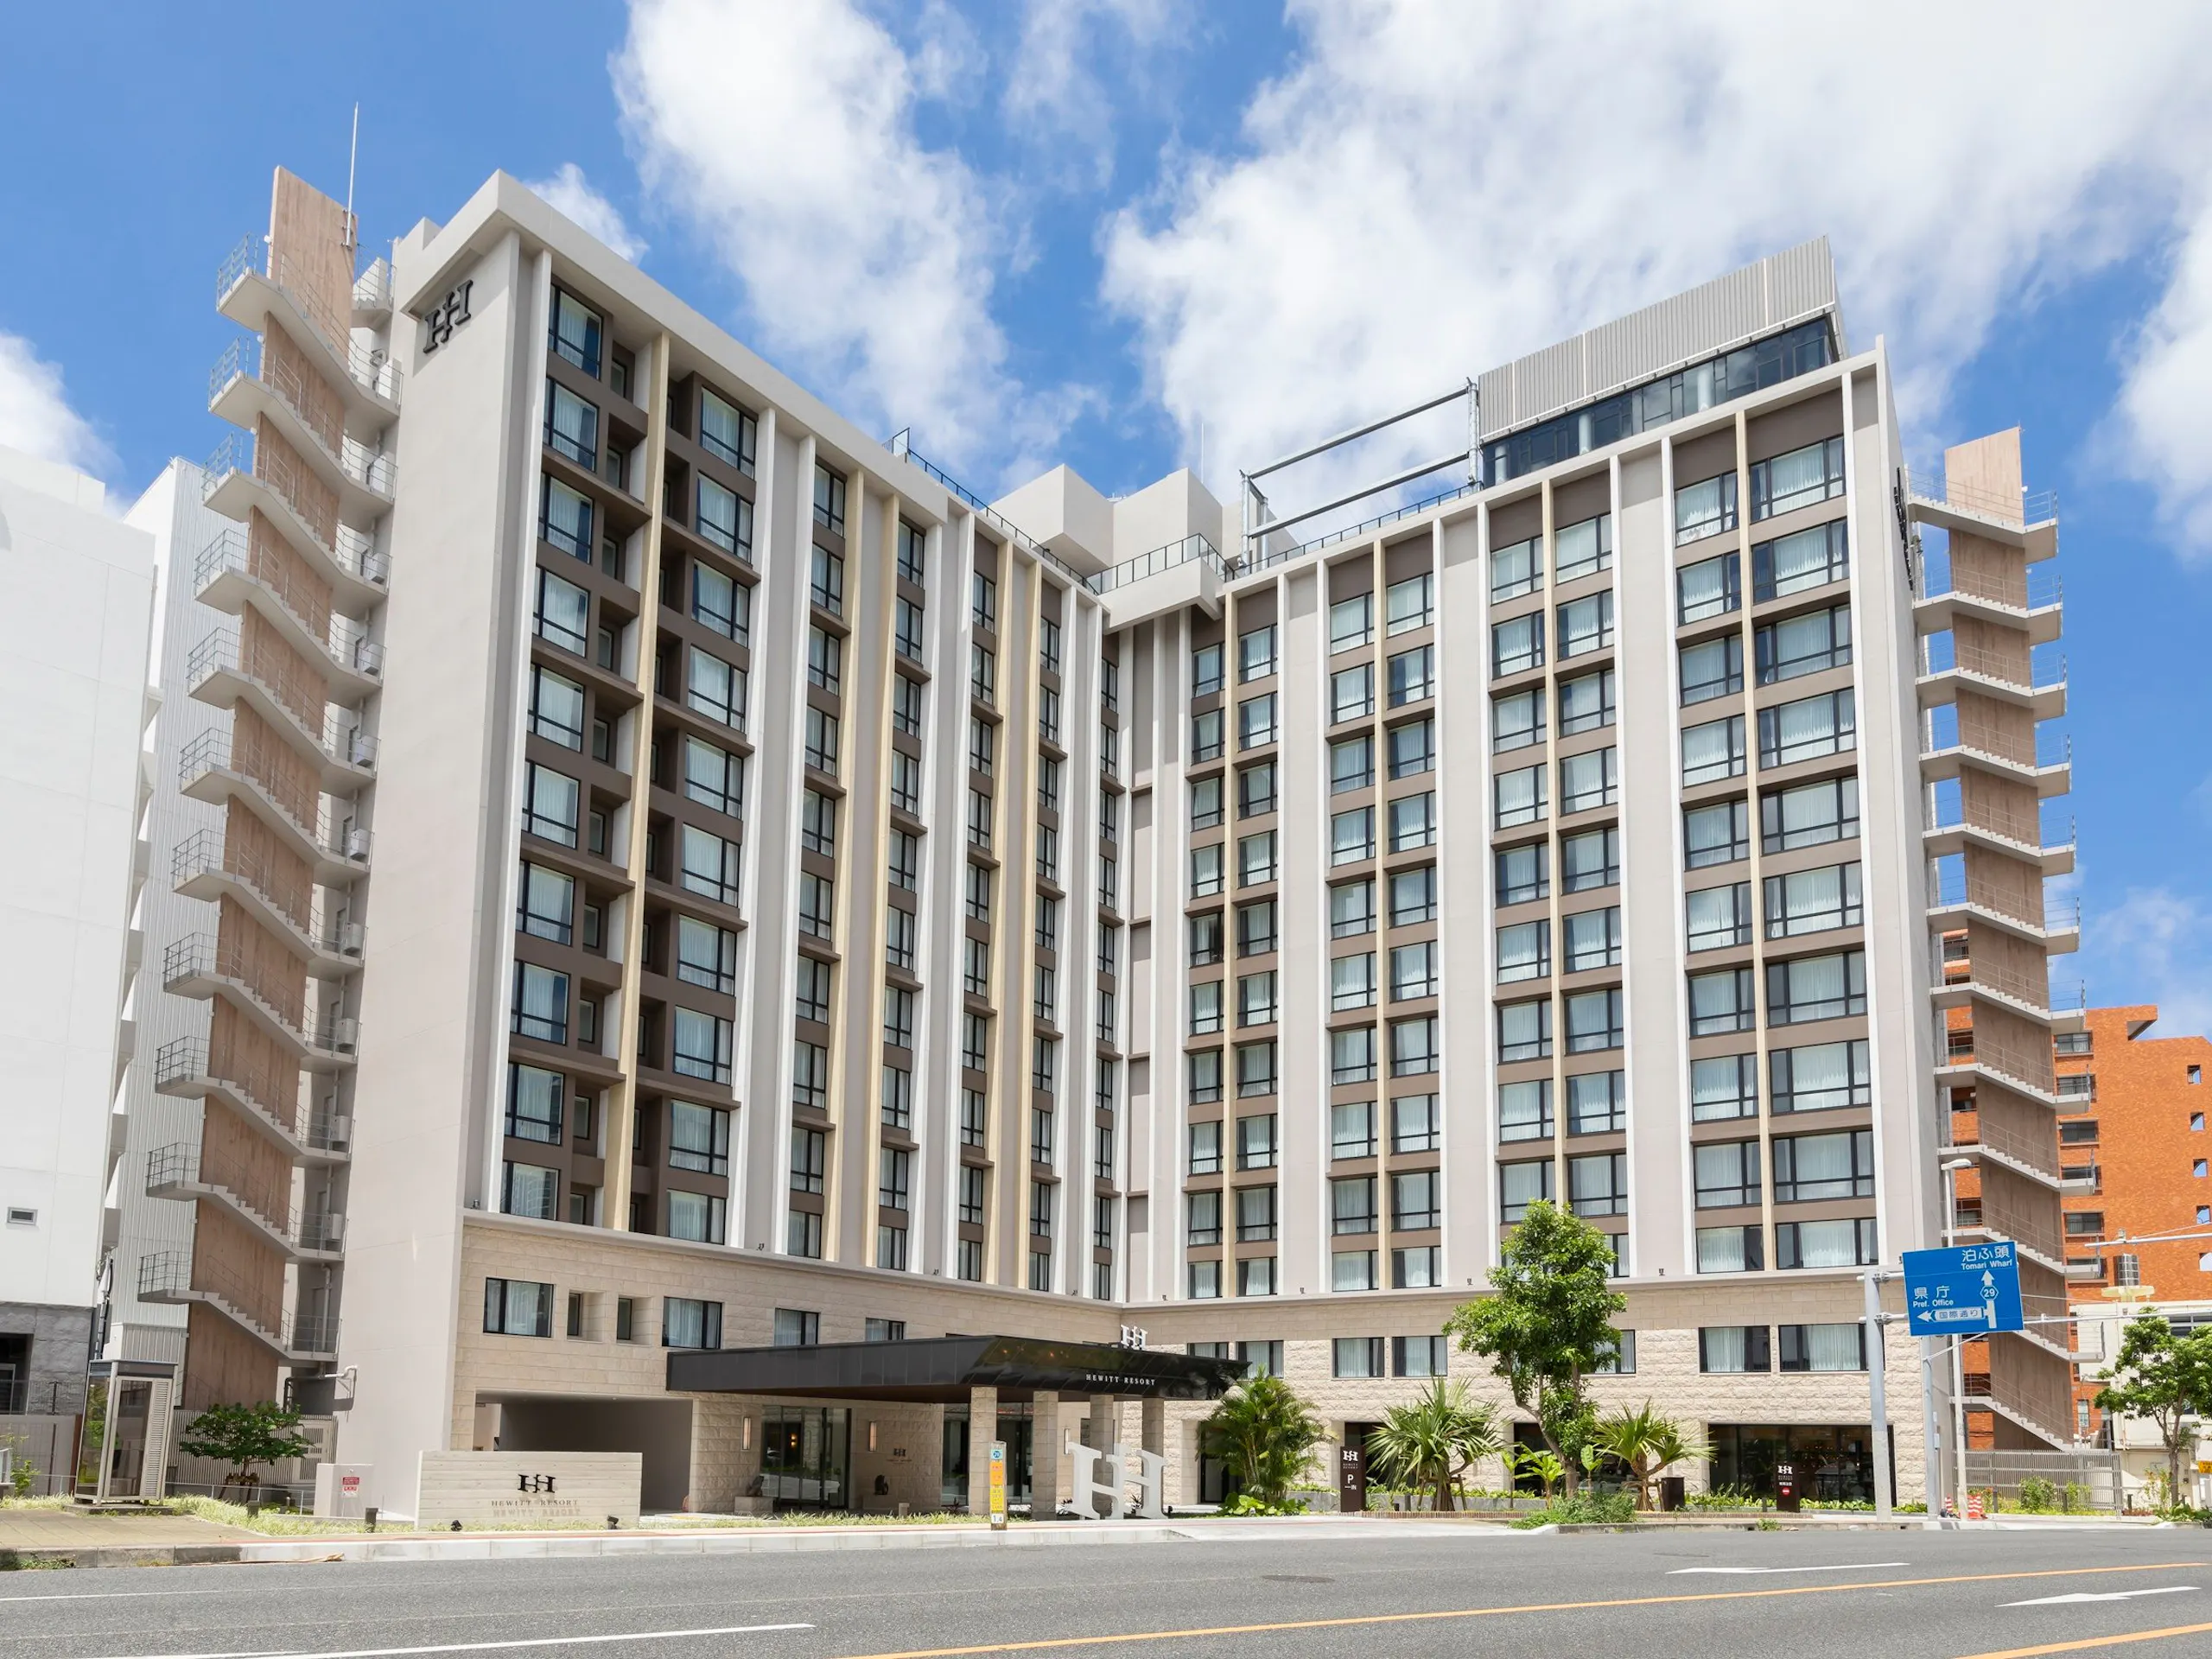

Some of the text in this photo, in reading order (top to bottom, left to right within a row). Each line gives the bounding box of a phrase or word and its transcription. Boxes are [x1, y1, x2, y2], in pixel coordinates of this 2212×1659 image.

[1962, 1245, 2010, 1262] 泊ふ頭
[1961, 1259, 2012, 1270] Tomari Wharf
[1984, 1288, 1995, 1297] 29
[1085, 1374, 1155, 1386] HEWITT RESORT
[1348, 1474, 1354, 1484] P
